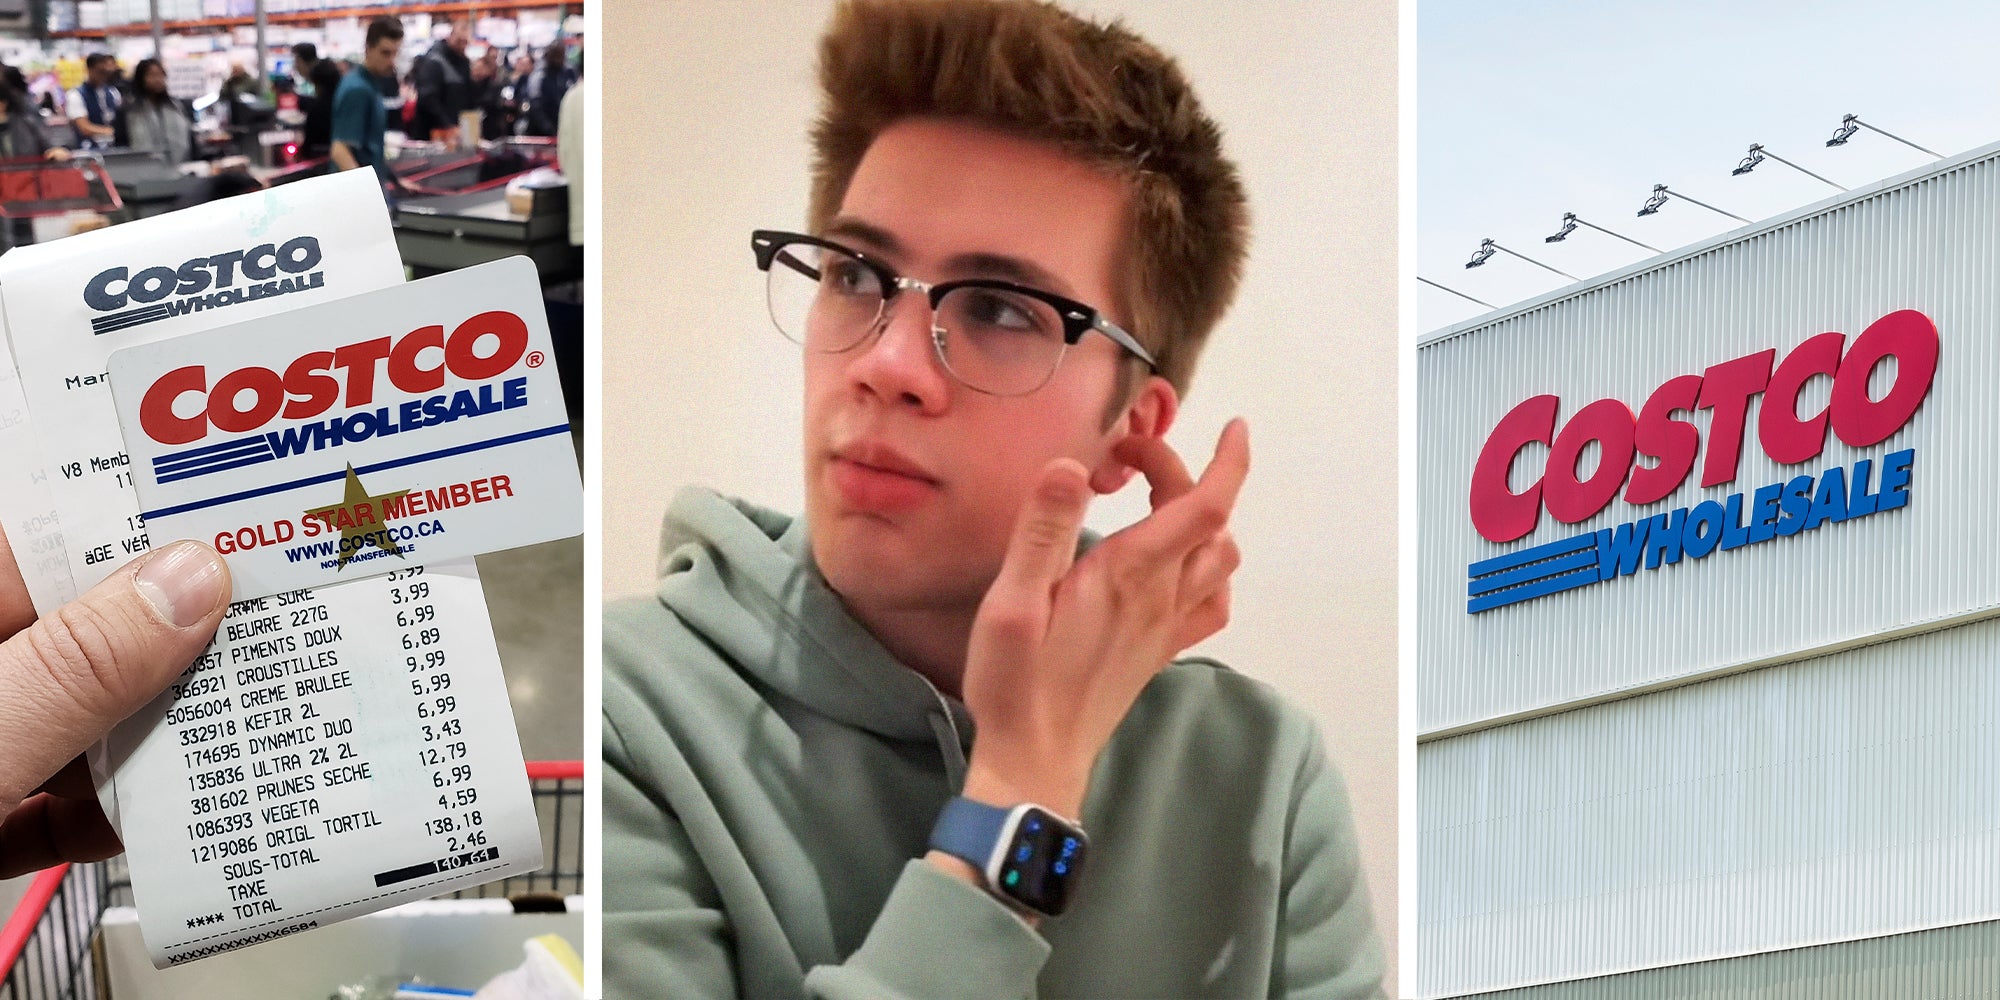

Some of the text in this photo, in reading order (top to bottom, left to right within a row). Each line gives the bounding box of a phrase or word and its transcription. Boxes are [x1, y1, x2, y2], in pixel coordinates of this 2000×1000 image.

[83, 236, 322, 311] COSTCO
[166, 271, 325, 317] WHOLESALE
[140, 310, 529, 445] COSTCO
[263, 376, 528, 460] WHOLESALE
[1469, 308, 1939, 543] COSTCO
[61, 462, 83, 479] V8
[214, 474, 514, 555] GOLD STAR MEMBER
[285, 519, 445, 563] WWW.COSTCO.CA
[1594, 448, 1915, 581] WHOLESALE
[320, 543, 415, 570] NON-TRANSFERABLE
[227, 614, 283, 642] BEURRE
[290, 605, 329, 627] 227G
[390, 582, 430, 604] 3,99
[276, 588, 315, 607] SURE
[171, 628, 440, 701] 366921 CROUSTILLES 6,89
[231, 636, 296, 664] PIMENTS
[304, 625, 343, 648] DOUX
[396, 605, 435, 627] 6,99
[166, 650, 445, 726] 5056004 CREME BRULEE 9,99
[179, 673, 451, 746] 332918 KEFIR 2L 5,99
[184, 696, 456, 768] 174695 DYNAMIC DUO 6,99
[188, 718, 462, 792] 135836 ULTRA 2% 2L 3,43
[187, 764, 472, 841] 1086393 VEGETA 6,99
[191, 741, 467, 815] 381602 PRUNES SECHE 12,79
[191, 787, 477, 864] 1219086 ORIGL TORTIL 4,59
[223, 810, 483, 881] SOUS-TOTAL 138,18
[227, 830, 487, 901] TAXE 2,46
[233, 898, 283, 920] TOTAL
